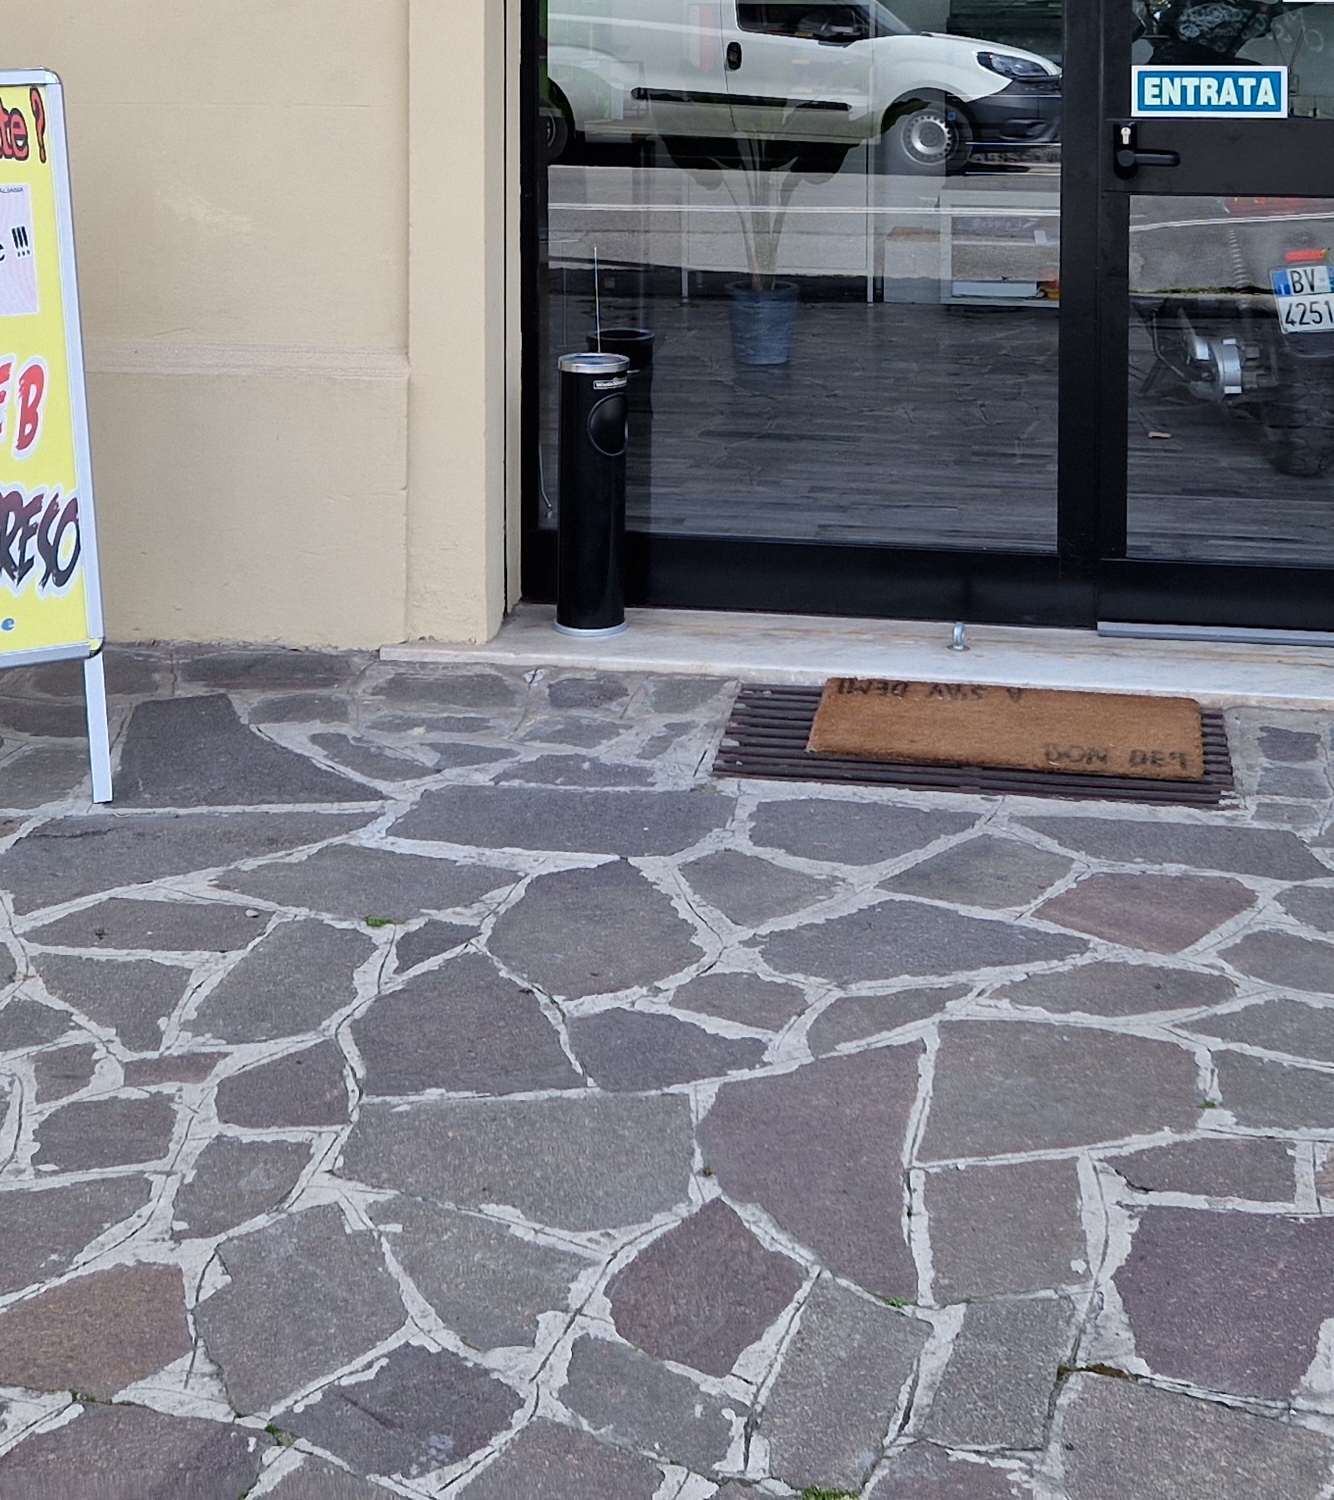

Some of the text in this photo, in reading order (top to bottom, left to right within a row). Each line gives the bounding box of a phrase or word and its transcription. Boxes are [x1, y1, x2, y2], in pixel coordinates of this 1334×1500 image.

[1144, 77, 1276, 106] ENTRATA
[1290, 268, 1315, 294] BV
[16, 364, 45, 451] B
